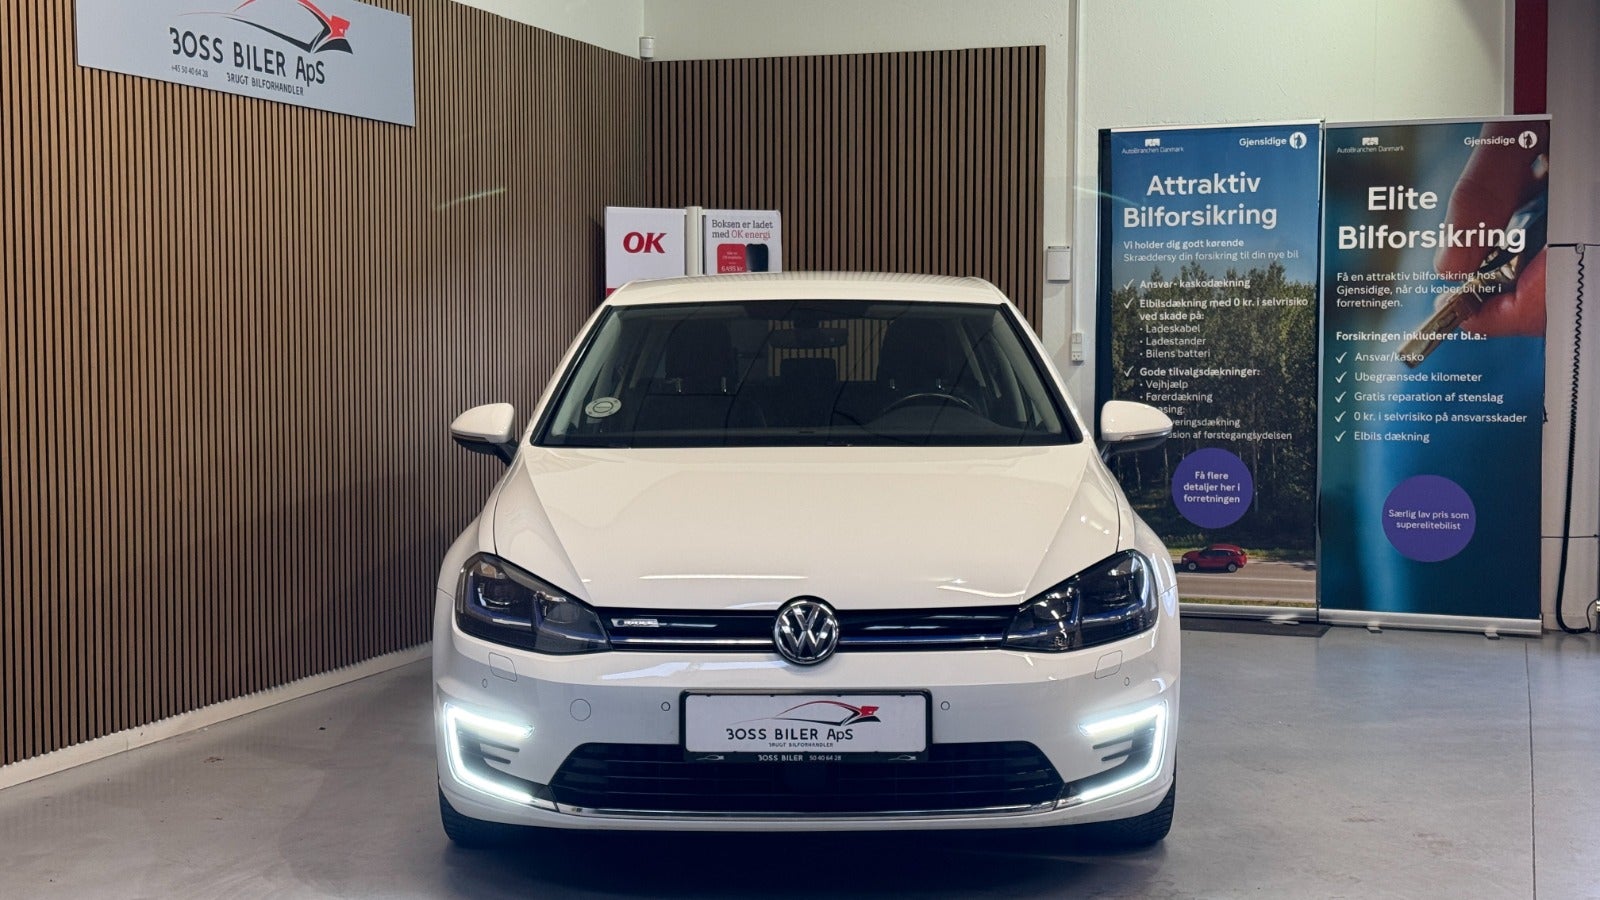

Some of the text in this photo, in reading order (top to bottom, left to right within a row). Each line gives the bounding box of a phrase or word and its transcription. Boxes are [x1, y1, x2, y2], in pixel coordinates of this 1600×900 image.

[233, 41, 286, 77] BILER
[295, 56, 325, 87] ApS
[252, 77, 304, 96] BILFORHANDLER
[1239, 137, 1287, 148] Gjensidige
[1464, 135, 1516, 147] Gjensidige
[1146, 171, 1261, 196] Attraktiv
[1368, 185, 1438, 211] Elite
[1123, 203, 1278, 230] Bilforsikring
[712, 219, 740, 228] Boksen
[752, 220, 774, 228] ladet
[712, 230, 771, 241] med OK energi
[1338, 222, 1526, 253] Bilforsikring
[623, 231, 667, 254] OK
[1123, 239, 1244, 250] Vi holder dig godt kørende
[1123, 250, 1299, 264] Skræddersy din forsikring til din nye bil
[1336, 271, 1349, 282] Få
[1366, 272, 1410, 282] attraktiv
[1412, 270, 1474, 282] bilforsikring
[1476, 270, 1496, 280] hos
[1140, 279, 1250, 290] Ansvar- kaskodækning
[1336, 284, 1393, 296] Gjensidige,
[1396, 284, 1412, 294] når
[1415, 284, 1428, 294] du
[1431, 284, 1460, 294] køber
[1462, 284, 1476, 293] bil
[1478, 283, 1496, 293] her
[1140, 299, 1208, 310] Elbilsdækning
[1210, 298, 1232, 308] med
[1234, 298, 1240, 307] 0
[1242, 298, 1255, 307] kr.
[1262, 298, 1308, 306] selvrisiko
[1336, 298, 1403, 309] forretningen.
[1140, 311, 1205, 322] ved skade på:
[1146, 324, 1201, 334] Ladeskabel
[1146, 336, 1206, 346] Ladestander
[1336, 331, 1487, 342] Forsikringen inkluderer bl.a.:
[1146, 349, 1211, 358] Bilens batteri
[1354, 352, 1424, 363] Ansvar/kasko
[1140, 366, 1260, 378] Gode tilvalgsdækninger:
[1354, 372, 1482, 384] Ubegrænsede kilometer
[1146, 380, 1188, 390] Vejhjælp
[1146, 392, 1213, 403] Førerdækning
[1354, 392, 1504, 404] Gratis reparation af stenslag
[1354, 412, 1360, 421] 0
[1363, 412, 1376, 422] kr.
[1384, 412, 1433, 422] selvrisiko
[1435, 412, 1448, 424] på
[1450, 413, 1528, 423] ansvarsskader
[1193, 430, 1202, 440] af
[1204, 430, 1293, 442] førstegangsydelsen
[1354, 432, 1430, 444] Elbils dækning
[1194, 470, 1229, 480] Få flere
[1184, 482, 1218, 493] detaljer
[1220, 483, 1236, 492] her
[1184, 494, 1240, 505] forretningen
[1388, 508, 1470, 520] Særlig lav pris som
[1396, 520, 1462, 530] superelitebilist
[774, 728, 818, 740] BILER
[826, 728, 854, 742] ApS
[781, 754, 804, 762] BILER
